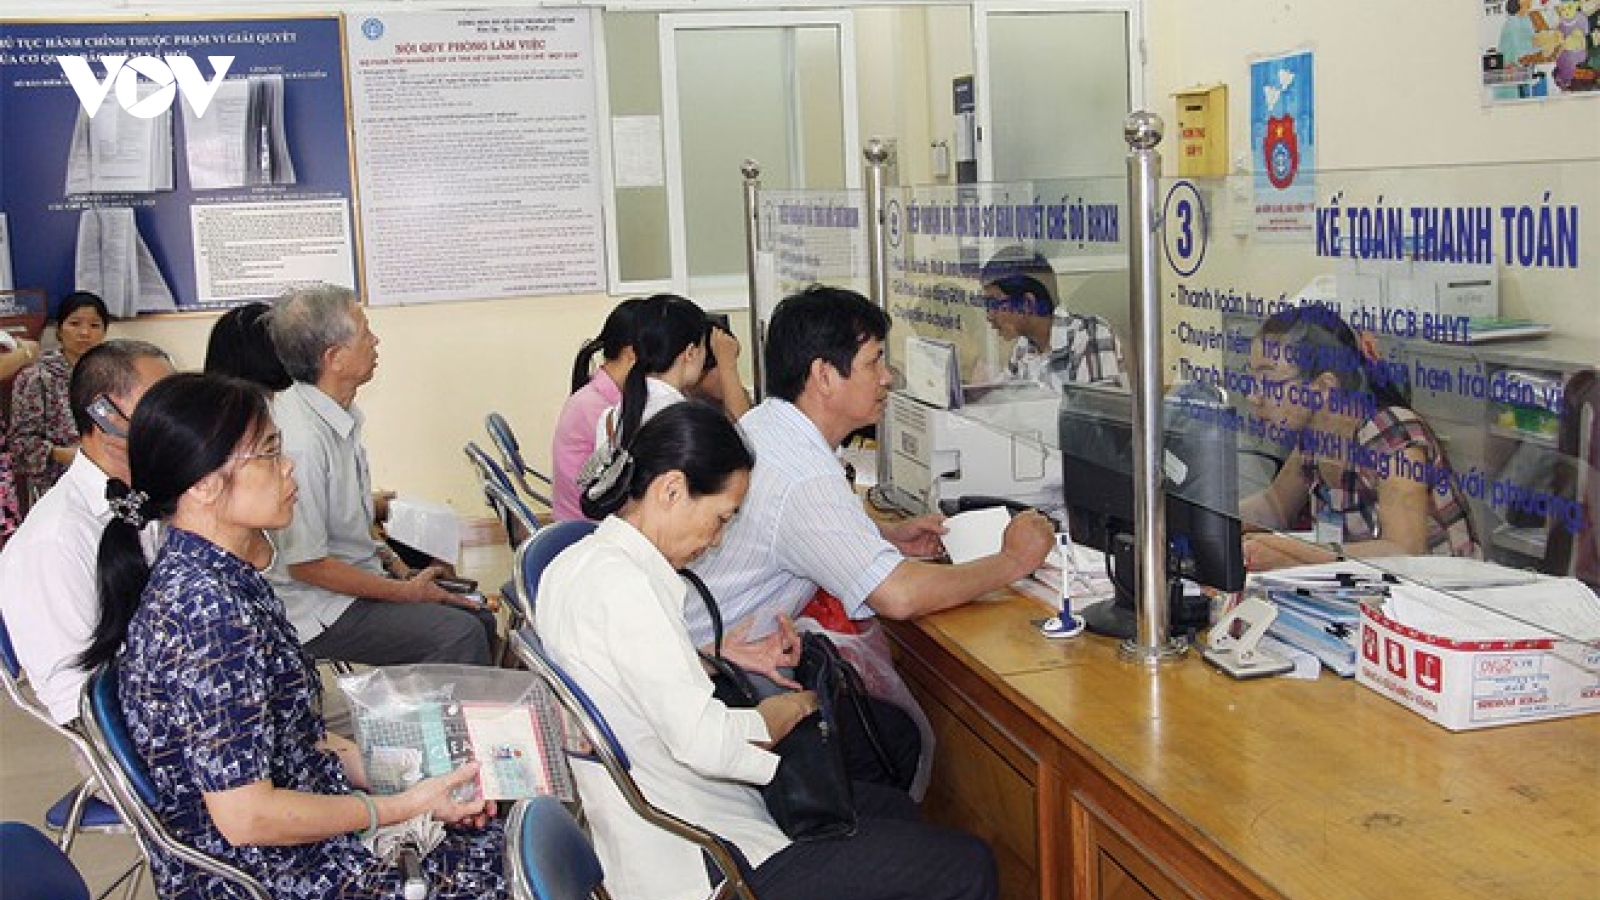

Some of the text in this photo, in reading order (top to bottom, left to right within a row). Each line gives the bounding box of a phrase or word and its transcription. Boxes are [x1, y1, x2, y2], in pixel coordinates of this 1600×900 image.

[1176, 190, 1579, 268] 3 KẾ TOÁN THANH TOÁN
[1178, 283, 1213, 311] Thanh
[1214, 288, 1244, 313] toán
[1349, 306, 1376, 332] chi
[1381, 306, 1417, 337] KCB
[1416, 359, 1453, 397] hạn
[1458, 363, 1486, 398] trả
[1456, 466, 1486, 499] với
